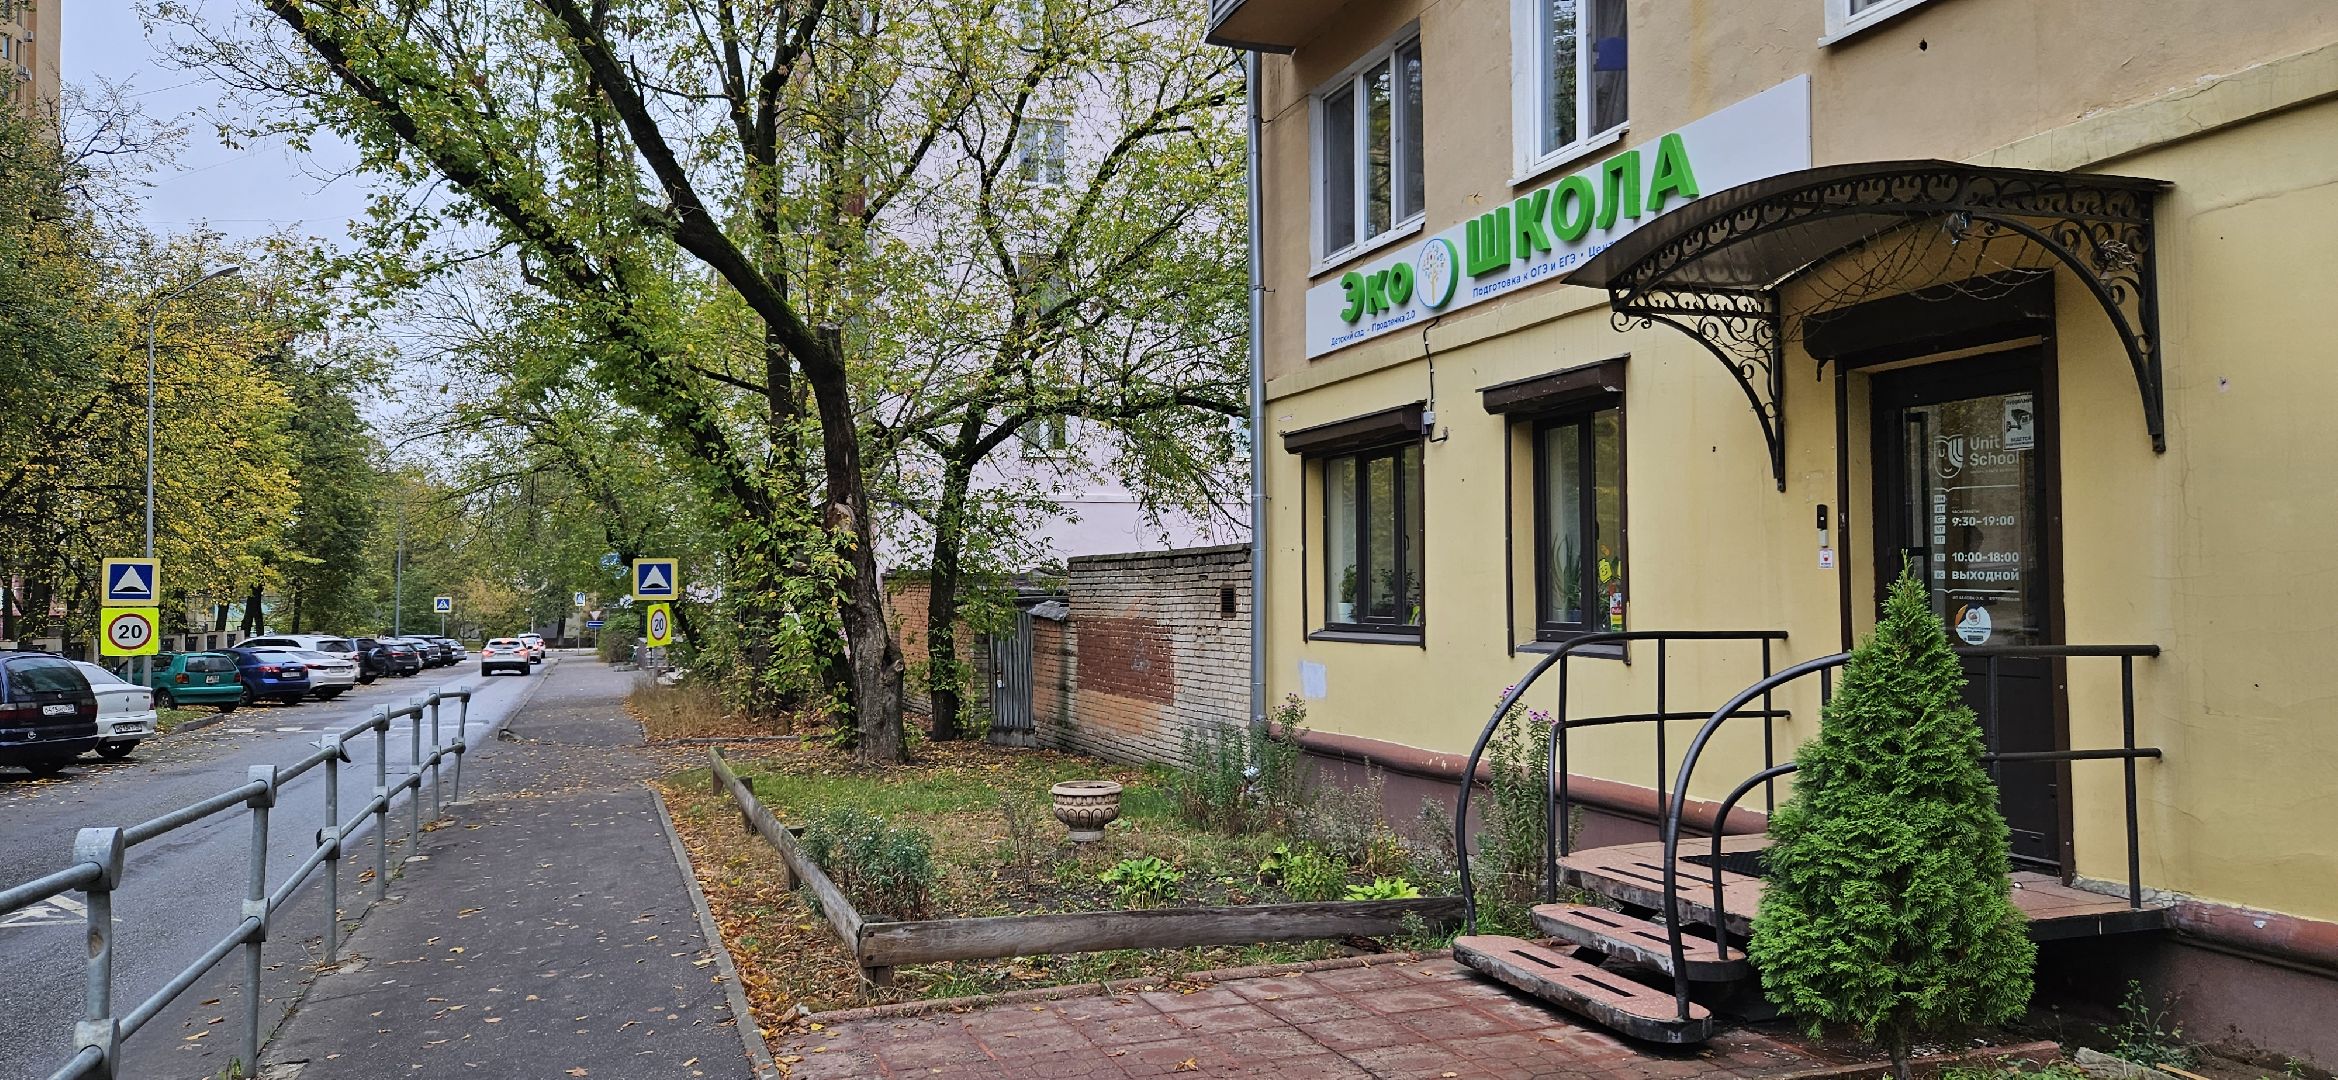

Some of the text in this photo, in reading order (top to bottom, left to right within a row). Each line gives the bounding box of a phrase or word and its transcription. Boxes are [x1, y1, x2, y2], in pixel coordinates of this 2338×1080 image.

[1466, 132, 1699, 278] ШКОЛА
[1472, 275, 1521, 298] Подготовка
[1523, 272, 1529, 281] к
[1530, 263, 1548, 278] ОГЭ
[1550, 262, 1556, 272] и
[1559, 253, 1576, 268] ЕГЭ
[1406, 309, 1416, 321] 2.0
[1969, 435, 2000, 451] Unit
[1969, 451, 2020, 467] School
[1952, 552, 2019, 562] 10:00-18:00
[118, 624, 143, 639] 20
[654, 618, 664, 631] 20
